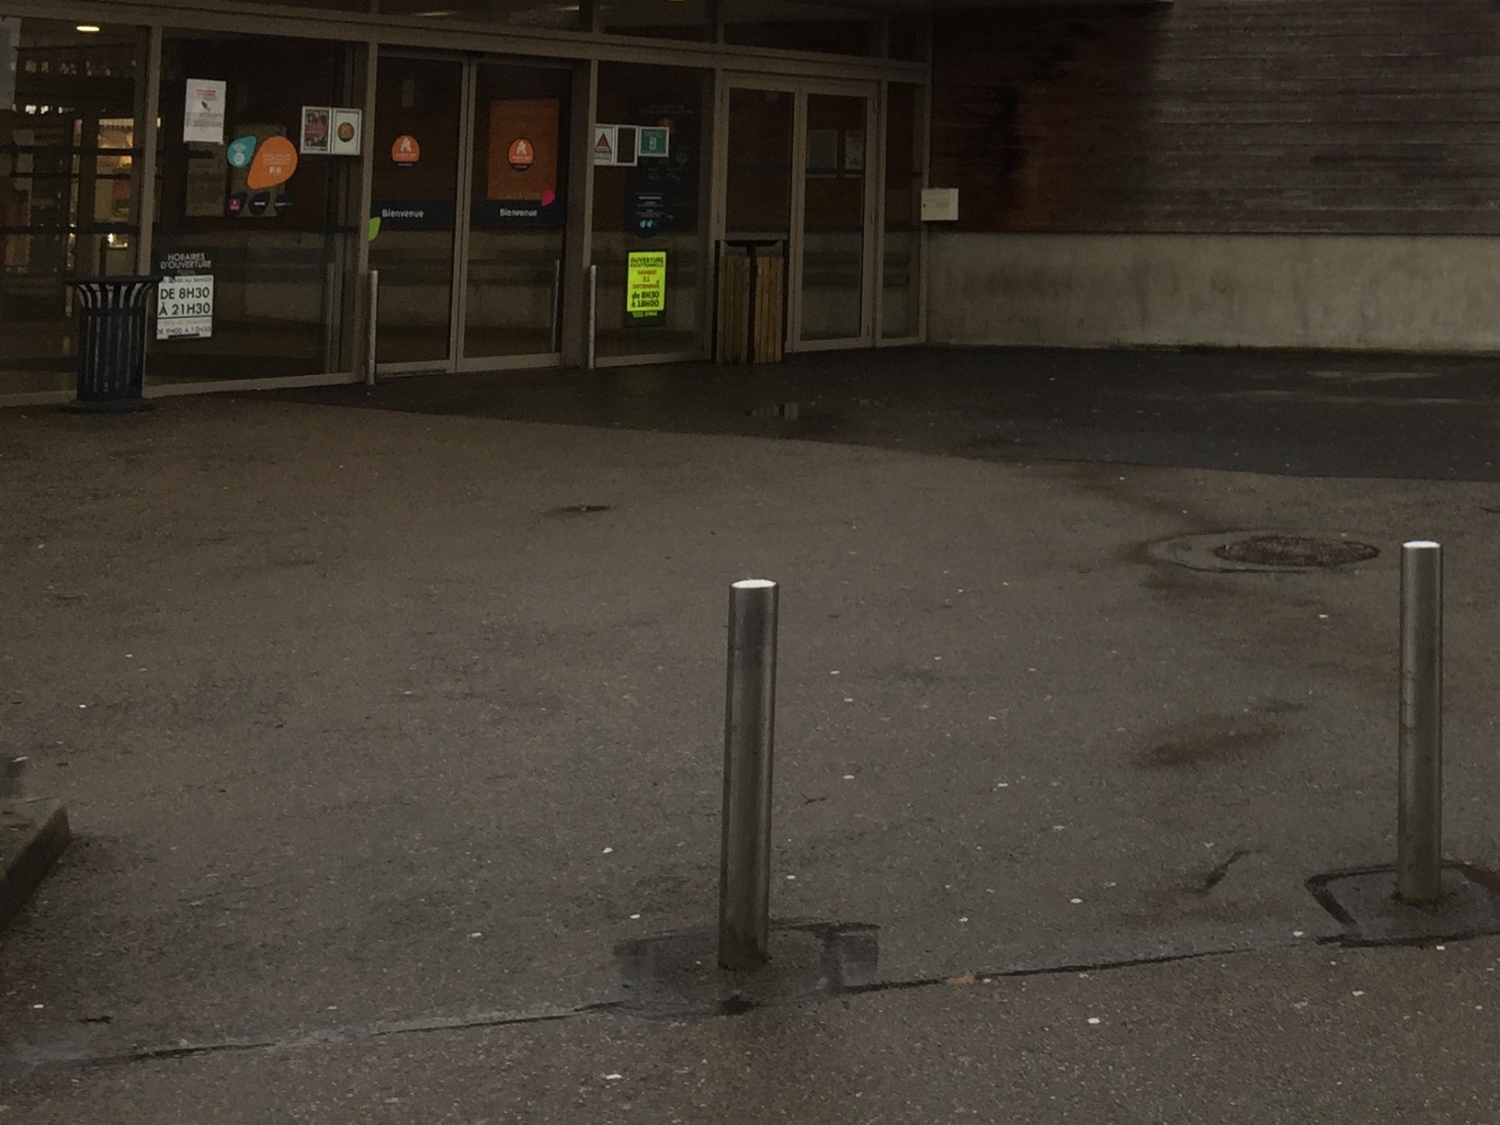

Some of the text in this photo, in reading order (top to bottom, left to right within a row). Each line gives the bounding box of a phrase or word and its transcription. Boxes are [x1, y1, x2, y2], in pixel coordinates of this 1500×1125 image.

[381, 208, 425, 218] Bienvenue
[167, 252, 205, 261] HORAIRES
[160, 260, 212, 270] D'OUVERTURE
[160, 286, 210, 300] DE 8H30
[158, 302, 211, 316] À 21H30
